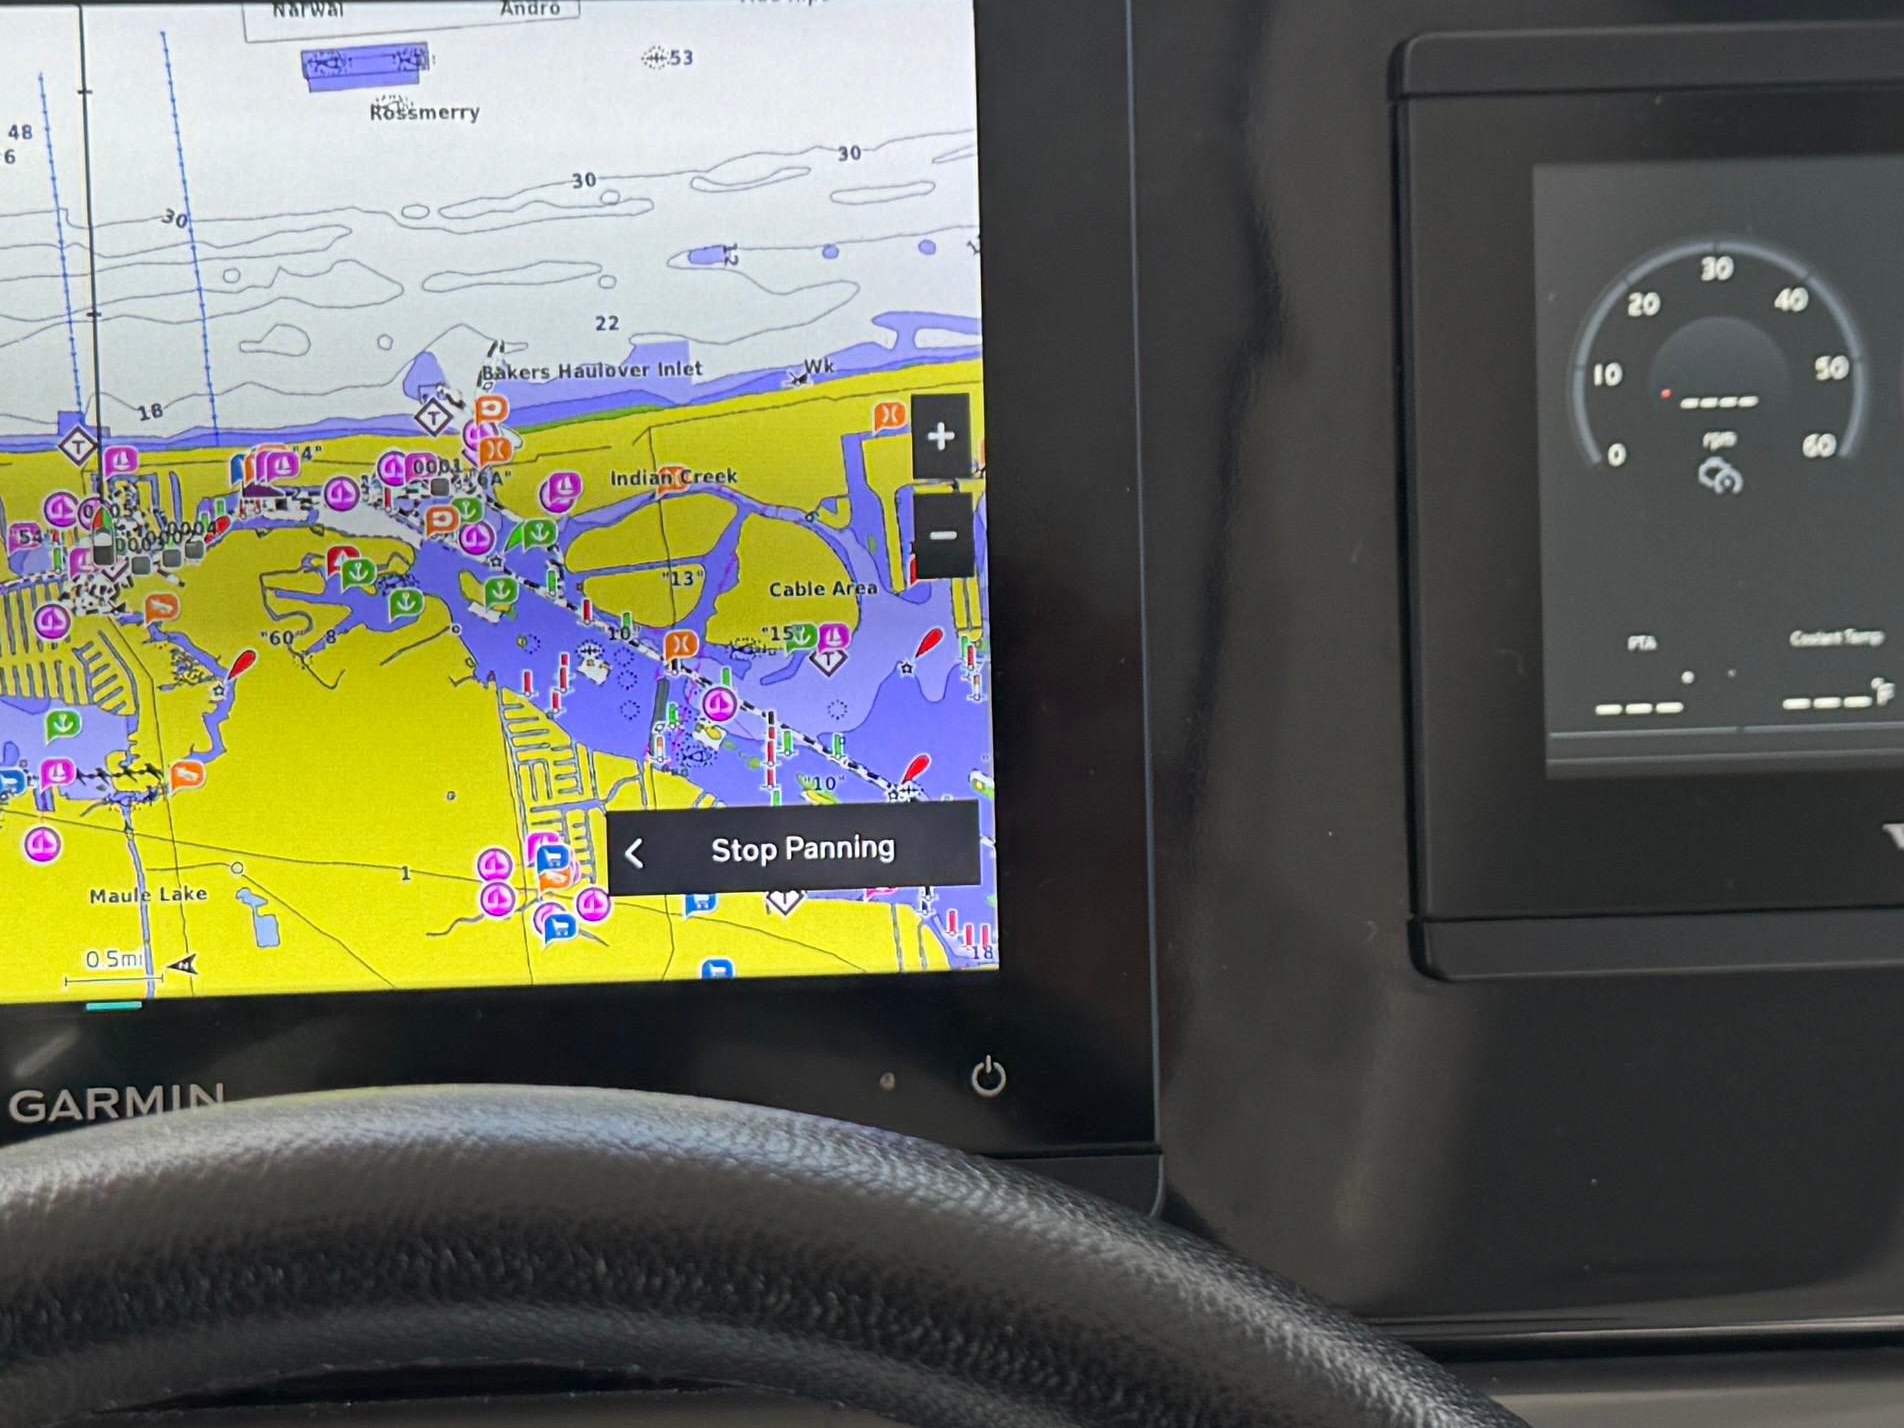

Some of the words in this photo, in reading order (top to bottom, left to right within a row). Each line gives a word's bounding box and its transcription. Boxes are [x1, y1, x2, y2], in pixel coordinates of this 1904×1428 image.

[669, 50, 694, 66] 53
[369, 103, 480, 124] Rossmerry
[8, 125, 33, 140] 48
[838, 145, 862, 162] 30
[572, 172, 597, 188] 30
[160, 208, 189, 229] 30
[1701, 256, 1734, 281] 30
[1628, 292, 1661, 317] 20
[1774, 287, 1809, 312] 40
[595, 315, 620, 331] 22
[482, 364, 550, 380] Bakers
[559, 361, 649, 379] Haulover
[658, 360, 703, 377] Inlet
[804, 358, 834, 374] Wk
[1593, 362, 1623, 386] 10
[1815, 355, 1849, 380] 50
[138, 403, 163, 421] 18
[1607, 443, 1627, 467] 0
[1803, 433, 1837, 458] 60
[611, 470, 672, 487] Indian
[681, 468, 737, 486] Creek
[769, 581, 826, 598] Cable
[832, 580, 878, 597] Area
[712, 838, 777, 866] Stop
[786, 834, 895, 865] Panning
[90, 888, 151, 904] Maule
[160, 886, 208, 902] Lake
[9, 1082, 225, 1124] GARMIN
